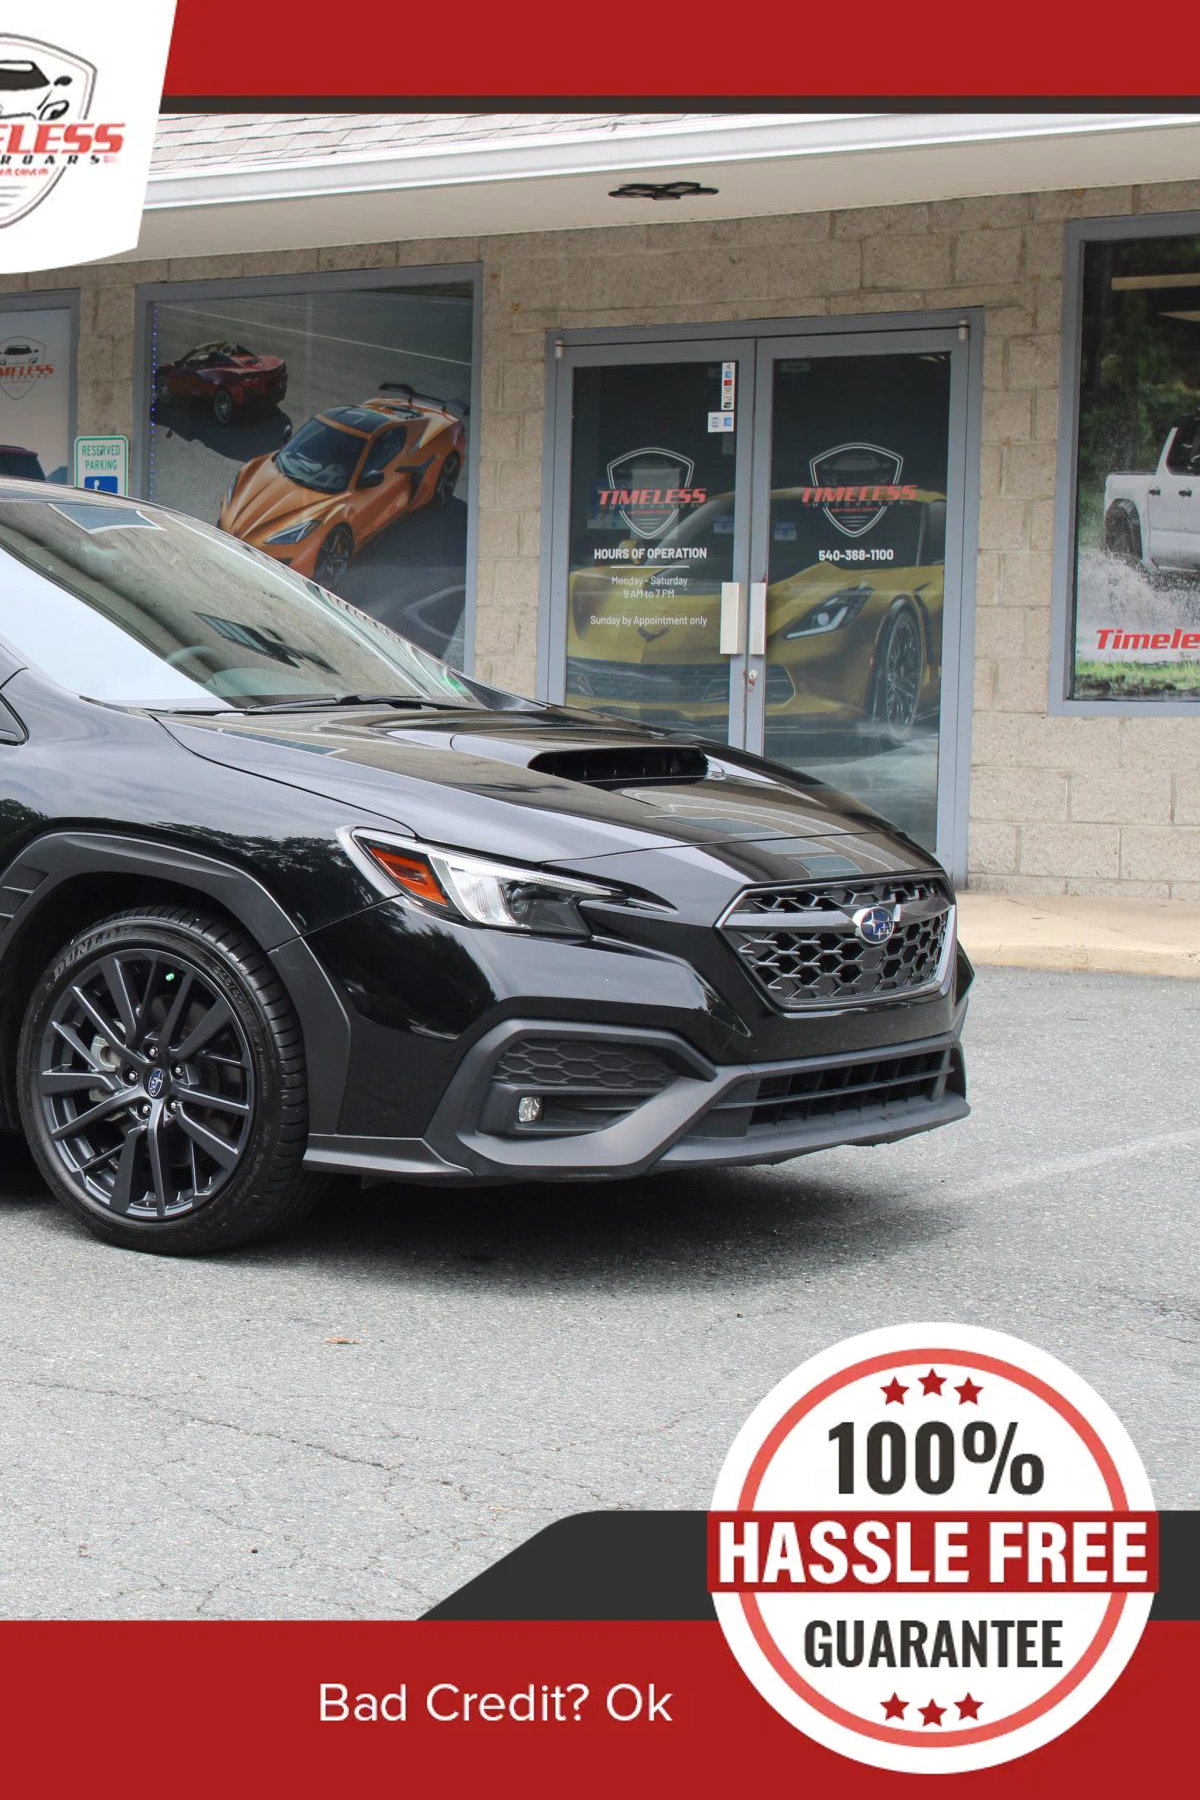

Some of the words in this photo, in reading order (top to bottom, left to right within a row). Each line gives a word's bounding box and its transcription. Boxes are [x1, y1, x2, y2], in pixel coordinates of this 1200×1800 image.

[81, 444, 121, 456] RESERVED
[85, 459, 118, 470] PARKING
[598, 488, 707, 505] TIMELESS
[800, 485, 918, 503] TIMELESS
[594, 548, 629, 560] HOURS
[631, 548, 645, 559] OF
[647, 547, 708, 559] OPERATION
[818, 549, 894, 561] 540-368-1100
[611, 576, 644, 587] Monday
[650, 576, 688, 587] Saturday
[623, 589, 629, 599] 9
[630, 589, 643, 599] AM
[644, 589, 654, 599] to
[655, 589, 661, 598] 7
[662, 588, 675, 598] PM
[590, 615, 621, 627] Sunday
[622, 615, 633, 627] by
[634, 615, 688, 627] Appointment
[689, 615, 708, 627] only
